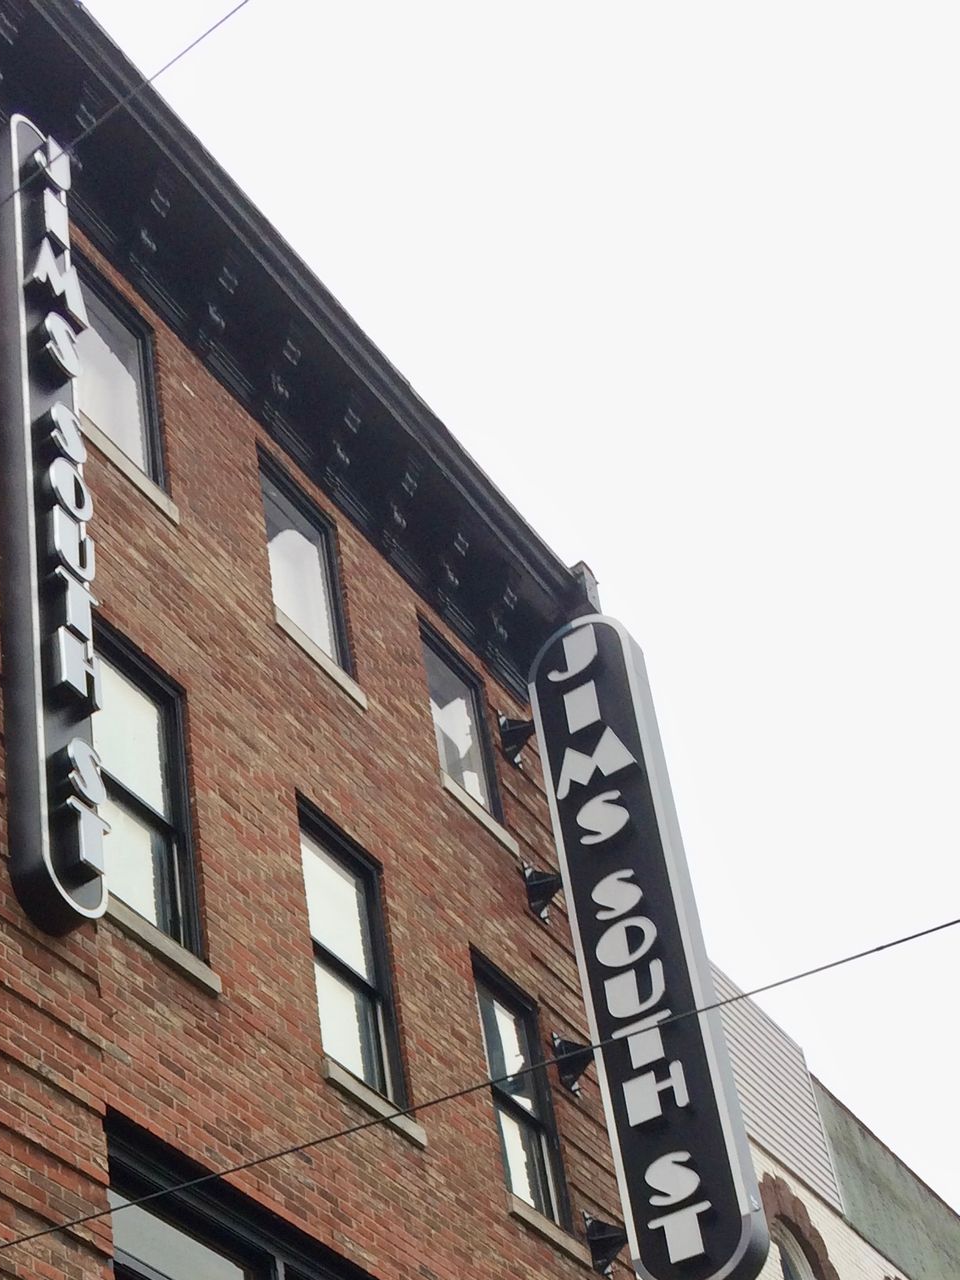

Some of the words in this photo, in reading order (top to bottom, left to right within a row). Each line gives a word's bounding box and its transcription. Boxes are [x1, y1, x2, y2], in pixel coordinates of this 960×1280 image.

[547, 623, 638, 845] JIMS
[591, 868, 690, 1128] SOUTH
[644, 1150, 712, 1265] ST
